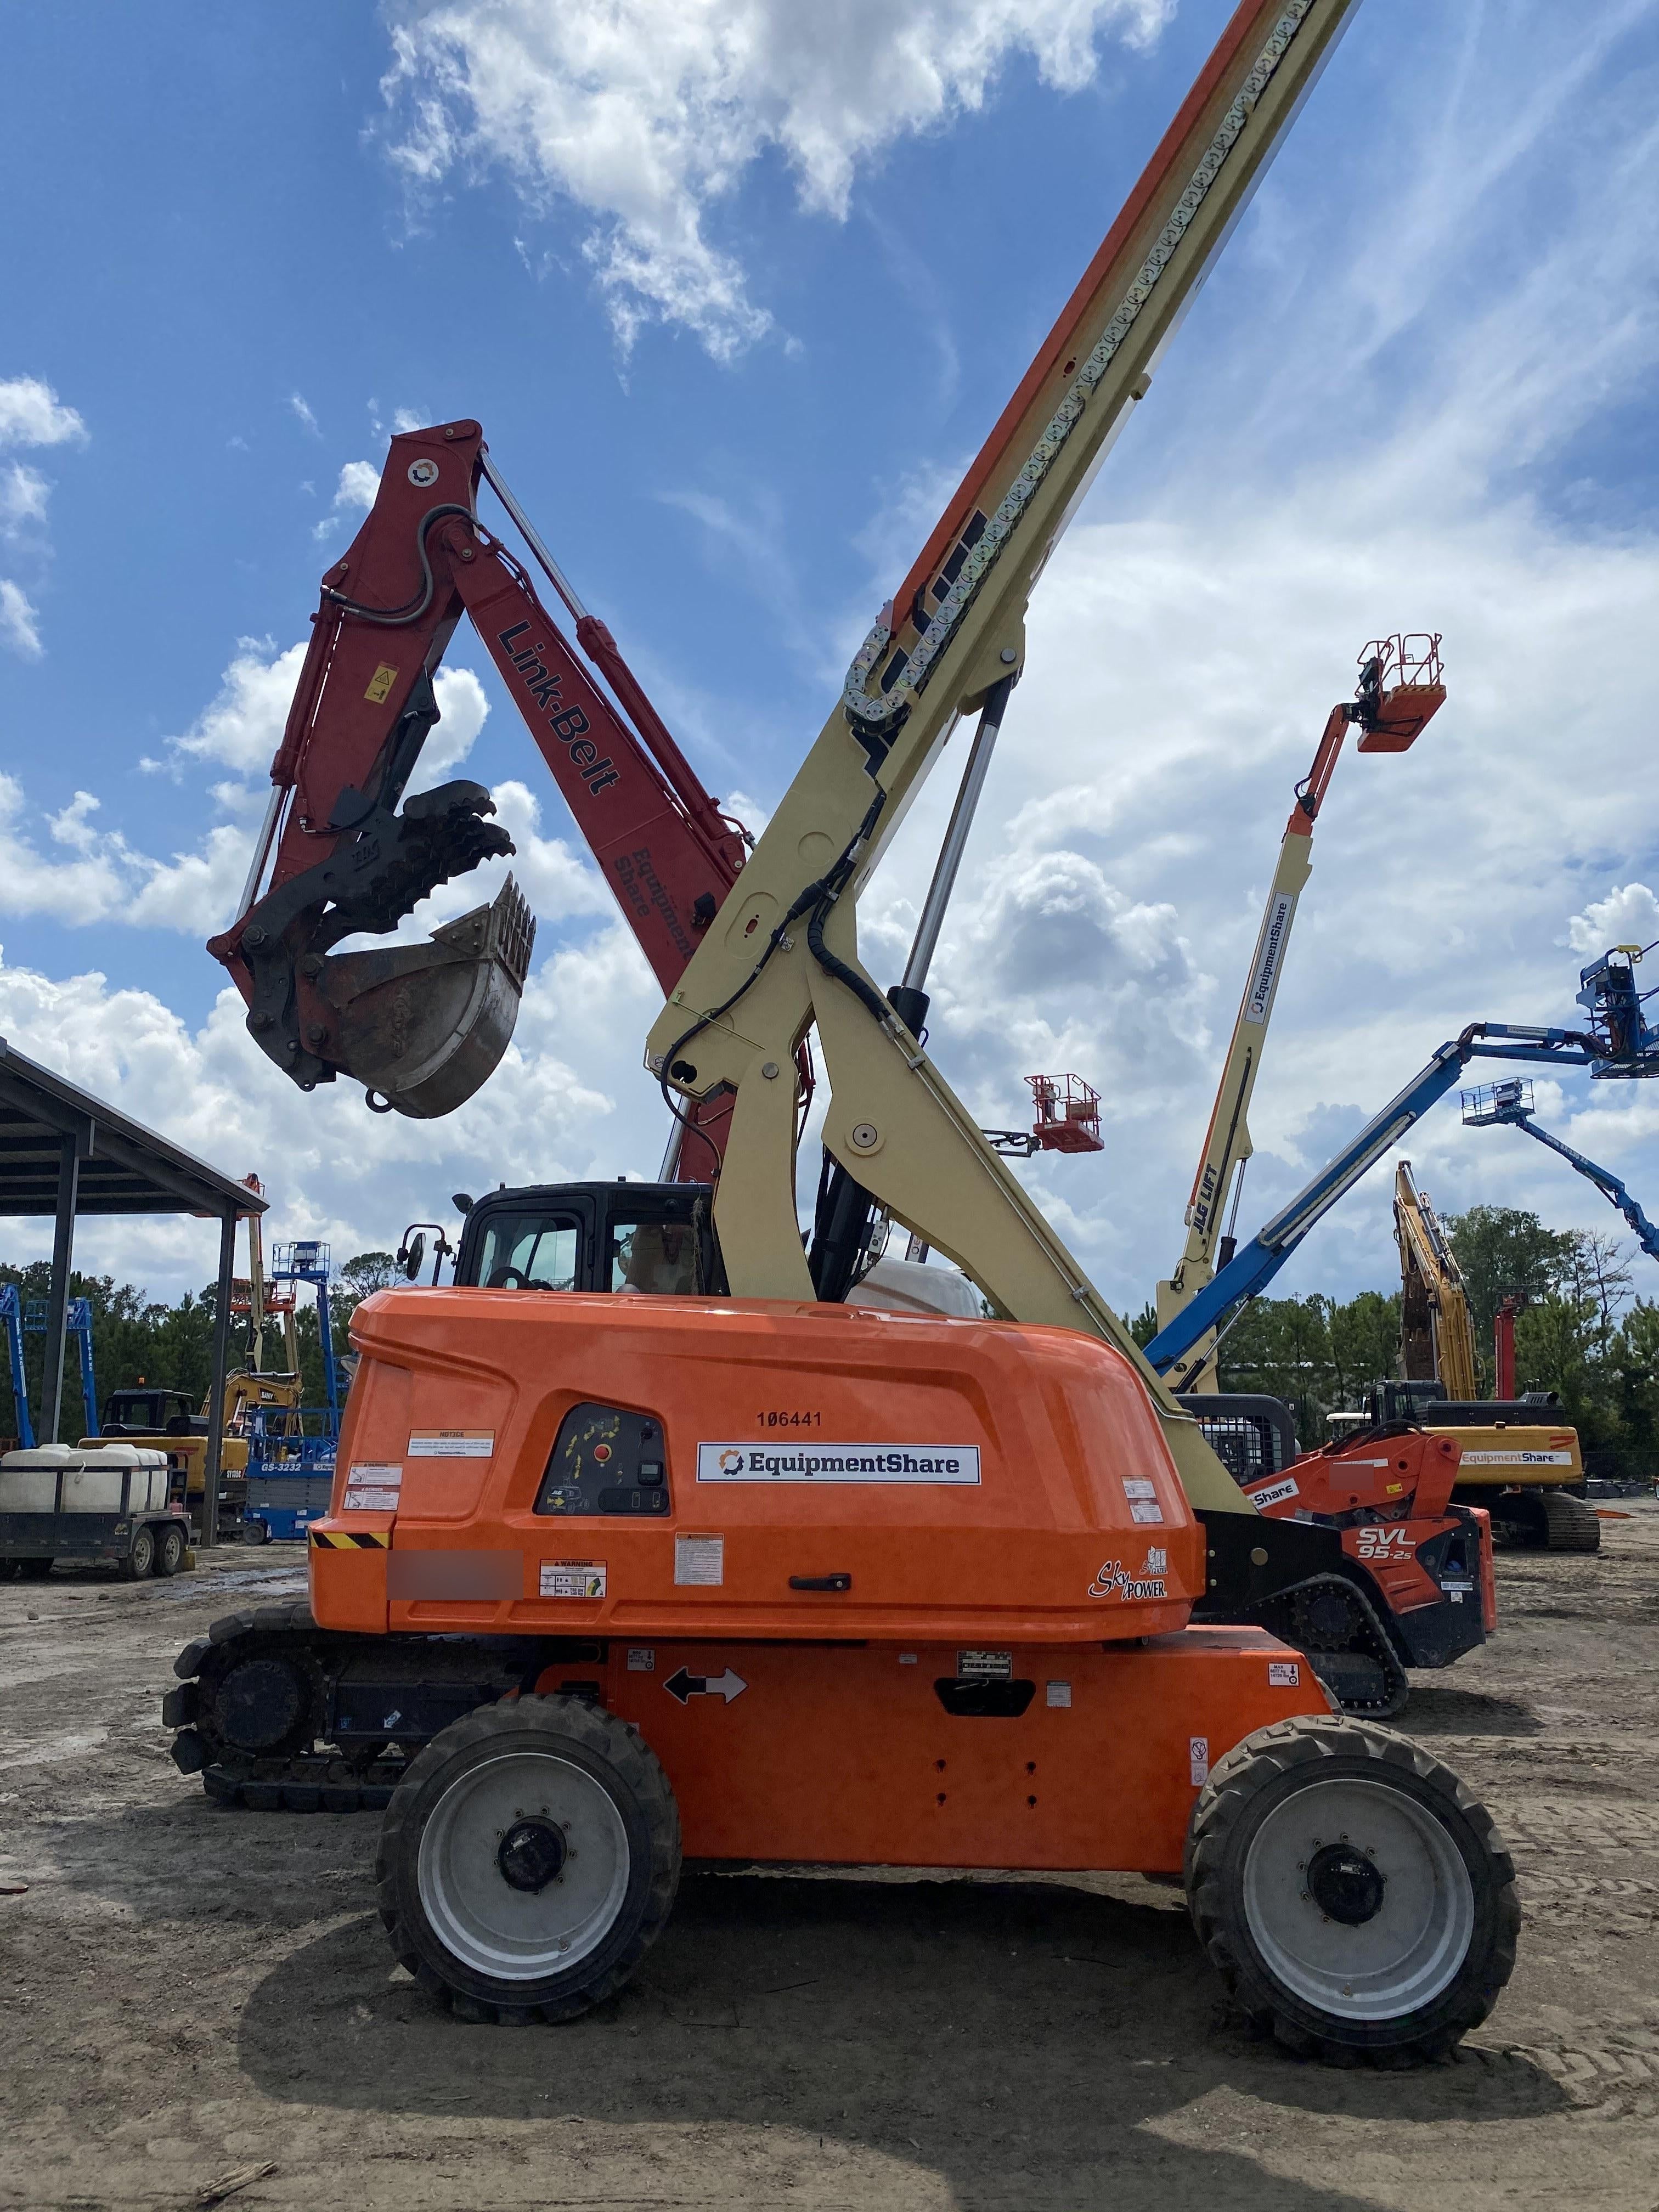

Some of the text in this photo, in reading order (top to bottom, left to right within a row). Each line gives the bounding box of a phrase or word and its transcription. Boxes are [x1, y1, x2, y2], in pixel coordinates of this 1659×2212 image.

[498, 619, 620, 796] Link-Belt
[614, 855, 650, 917] Share
[633, 847, 696, 960] Equipment
[1255, 902, 1287, 1001] EquipmentShare
[1193, 1163, 1217, 1235] JLG LIFT
[261, 1391, 274, 1400] SANY
[757, 1412, 821, 1426] 106441
[261, 1463, 302, 1472] GS-3232
[749, 1452, 960, 1476] EquipmentShare
[1462, 1453, 1554, 1464] EquipmentShare
[1356, 1528, 1417, 1545] SVL
[1088, 1560, 1166, 1601] Sky POWER
